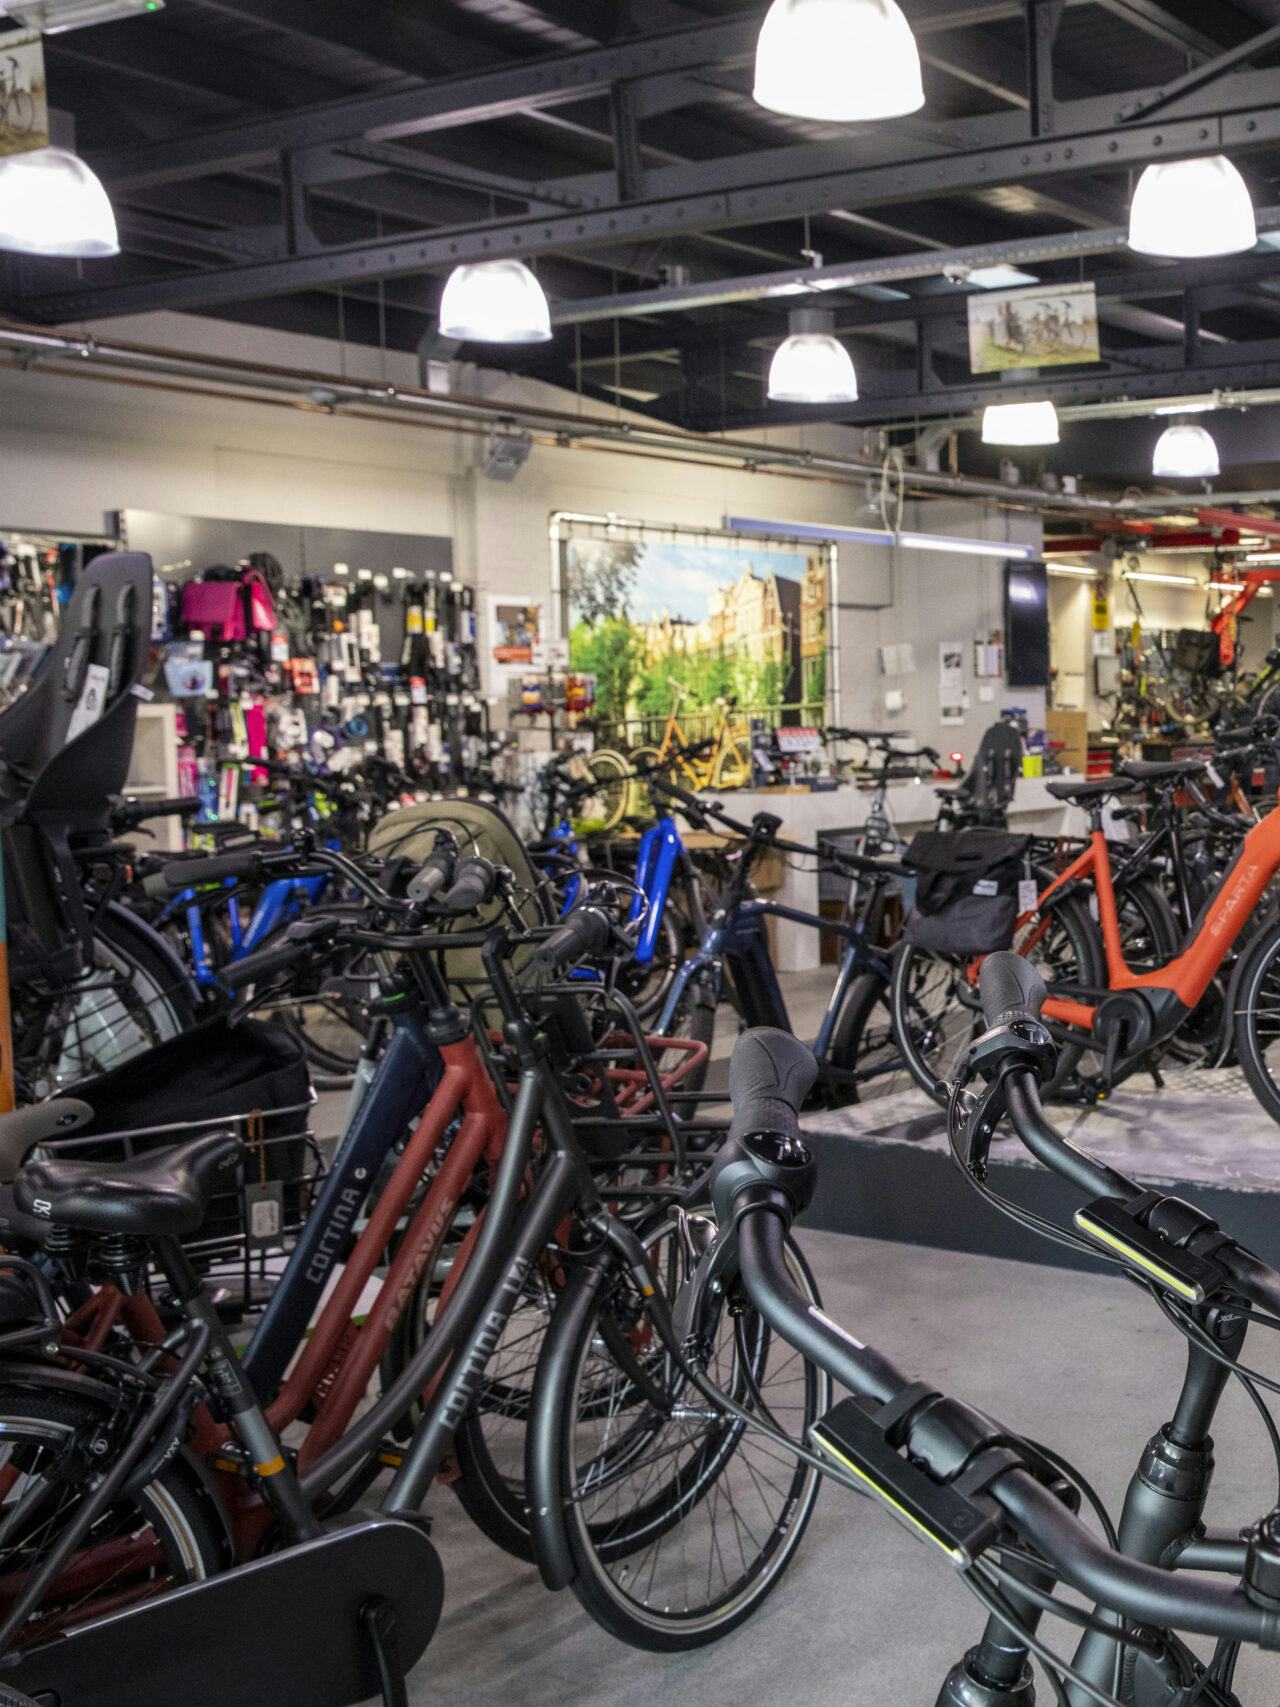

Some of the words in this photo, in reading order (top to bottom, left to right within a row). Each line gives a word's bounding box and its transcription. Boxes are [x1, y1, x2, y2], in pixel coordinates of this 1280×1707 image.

[1210, 865, 1259, 936] SPARTA
[305, 1187, 360, 1284] CORTINA
[384, 1198, 454, 1331] BATAVUS
[439, 1310, 506, 1430] CORTINA
